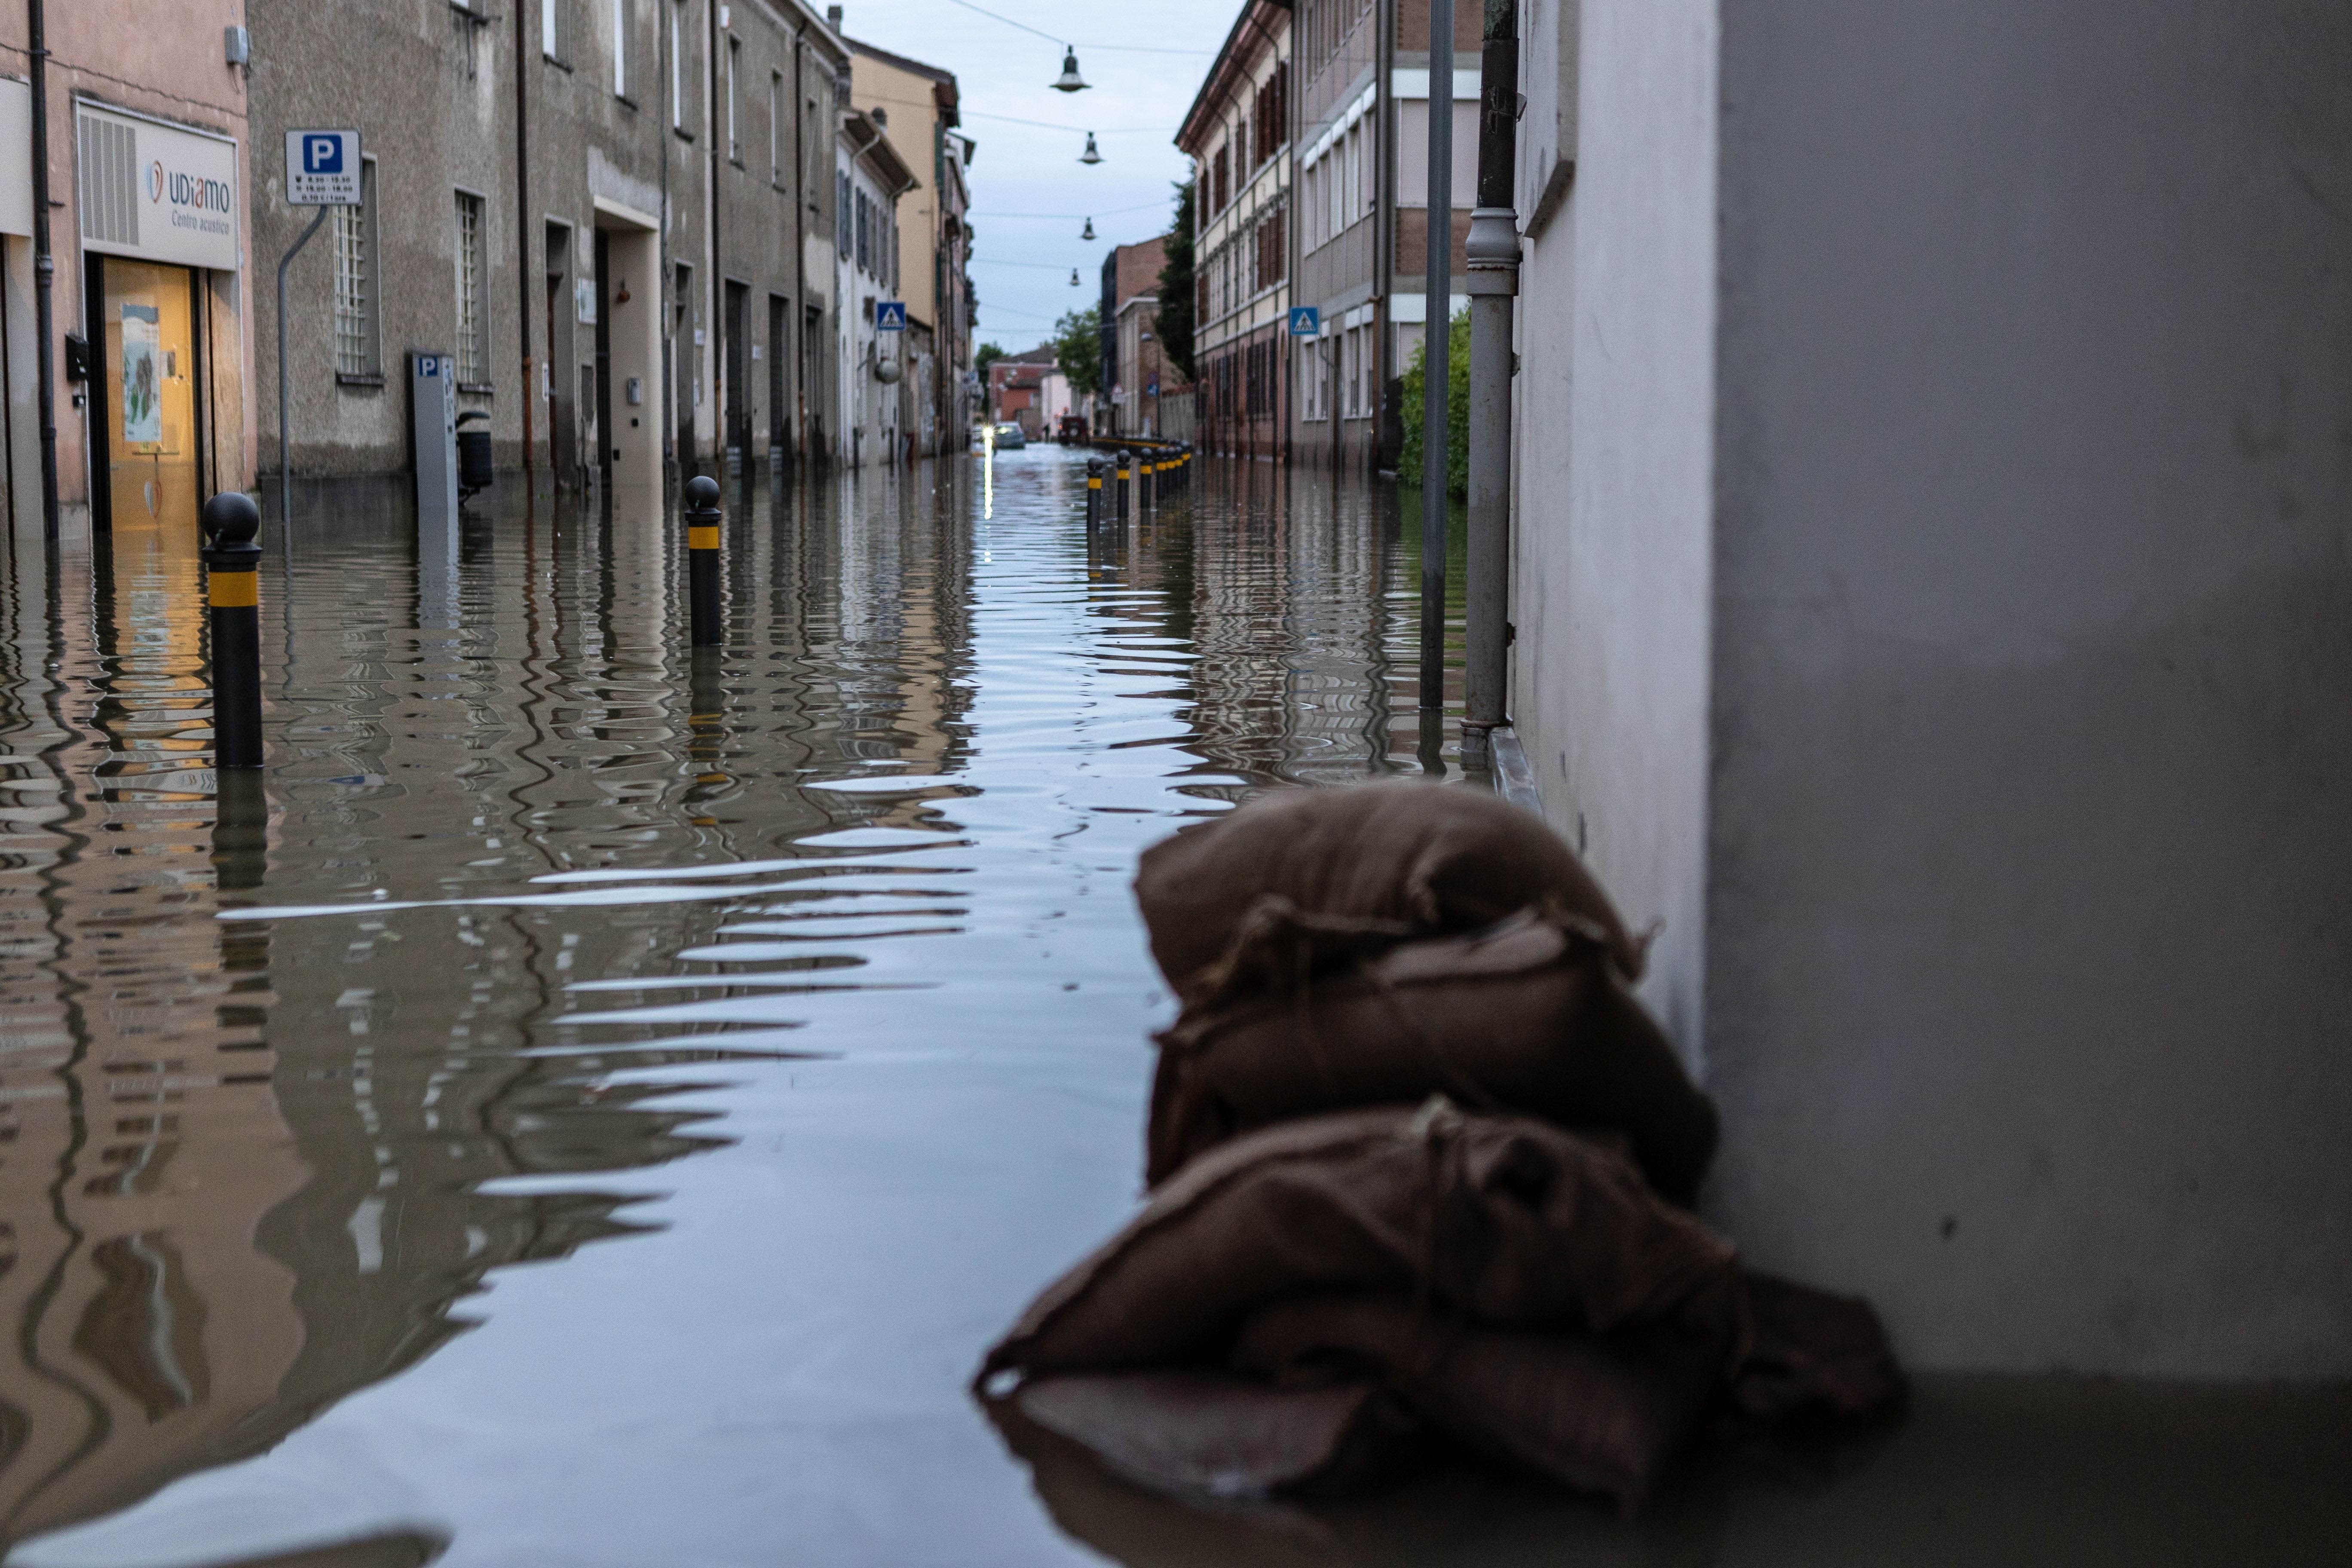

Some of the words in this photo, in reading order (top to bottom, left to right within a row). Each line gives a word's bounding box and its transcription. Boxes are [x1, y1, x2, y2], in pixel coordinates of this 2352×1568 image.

[311, 139, 334, 169] P
[172, 209, 197, 230] Centro
[422, 357, 436, 376] P
